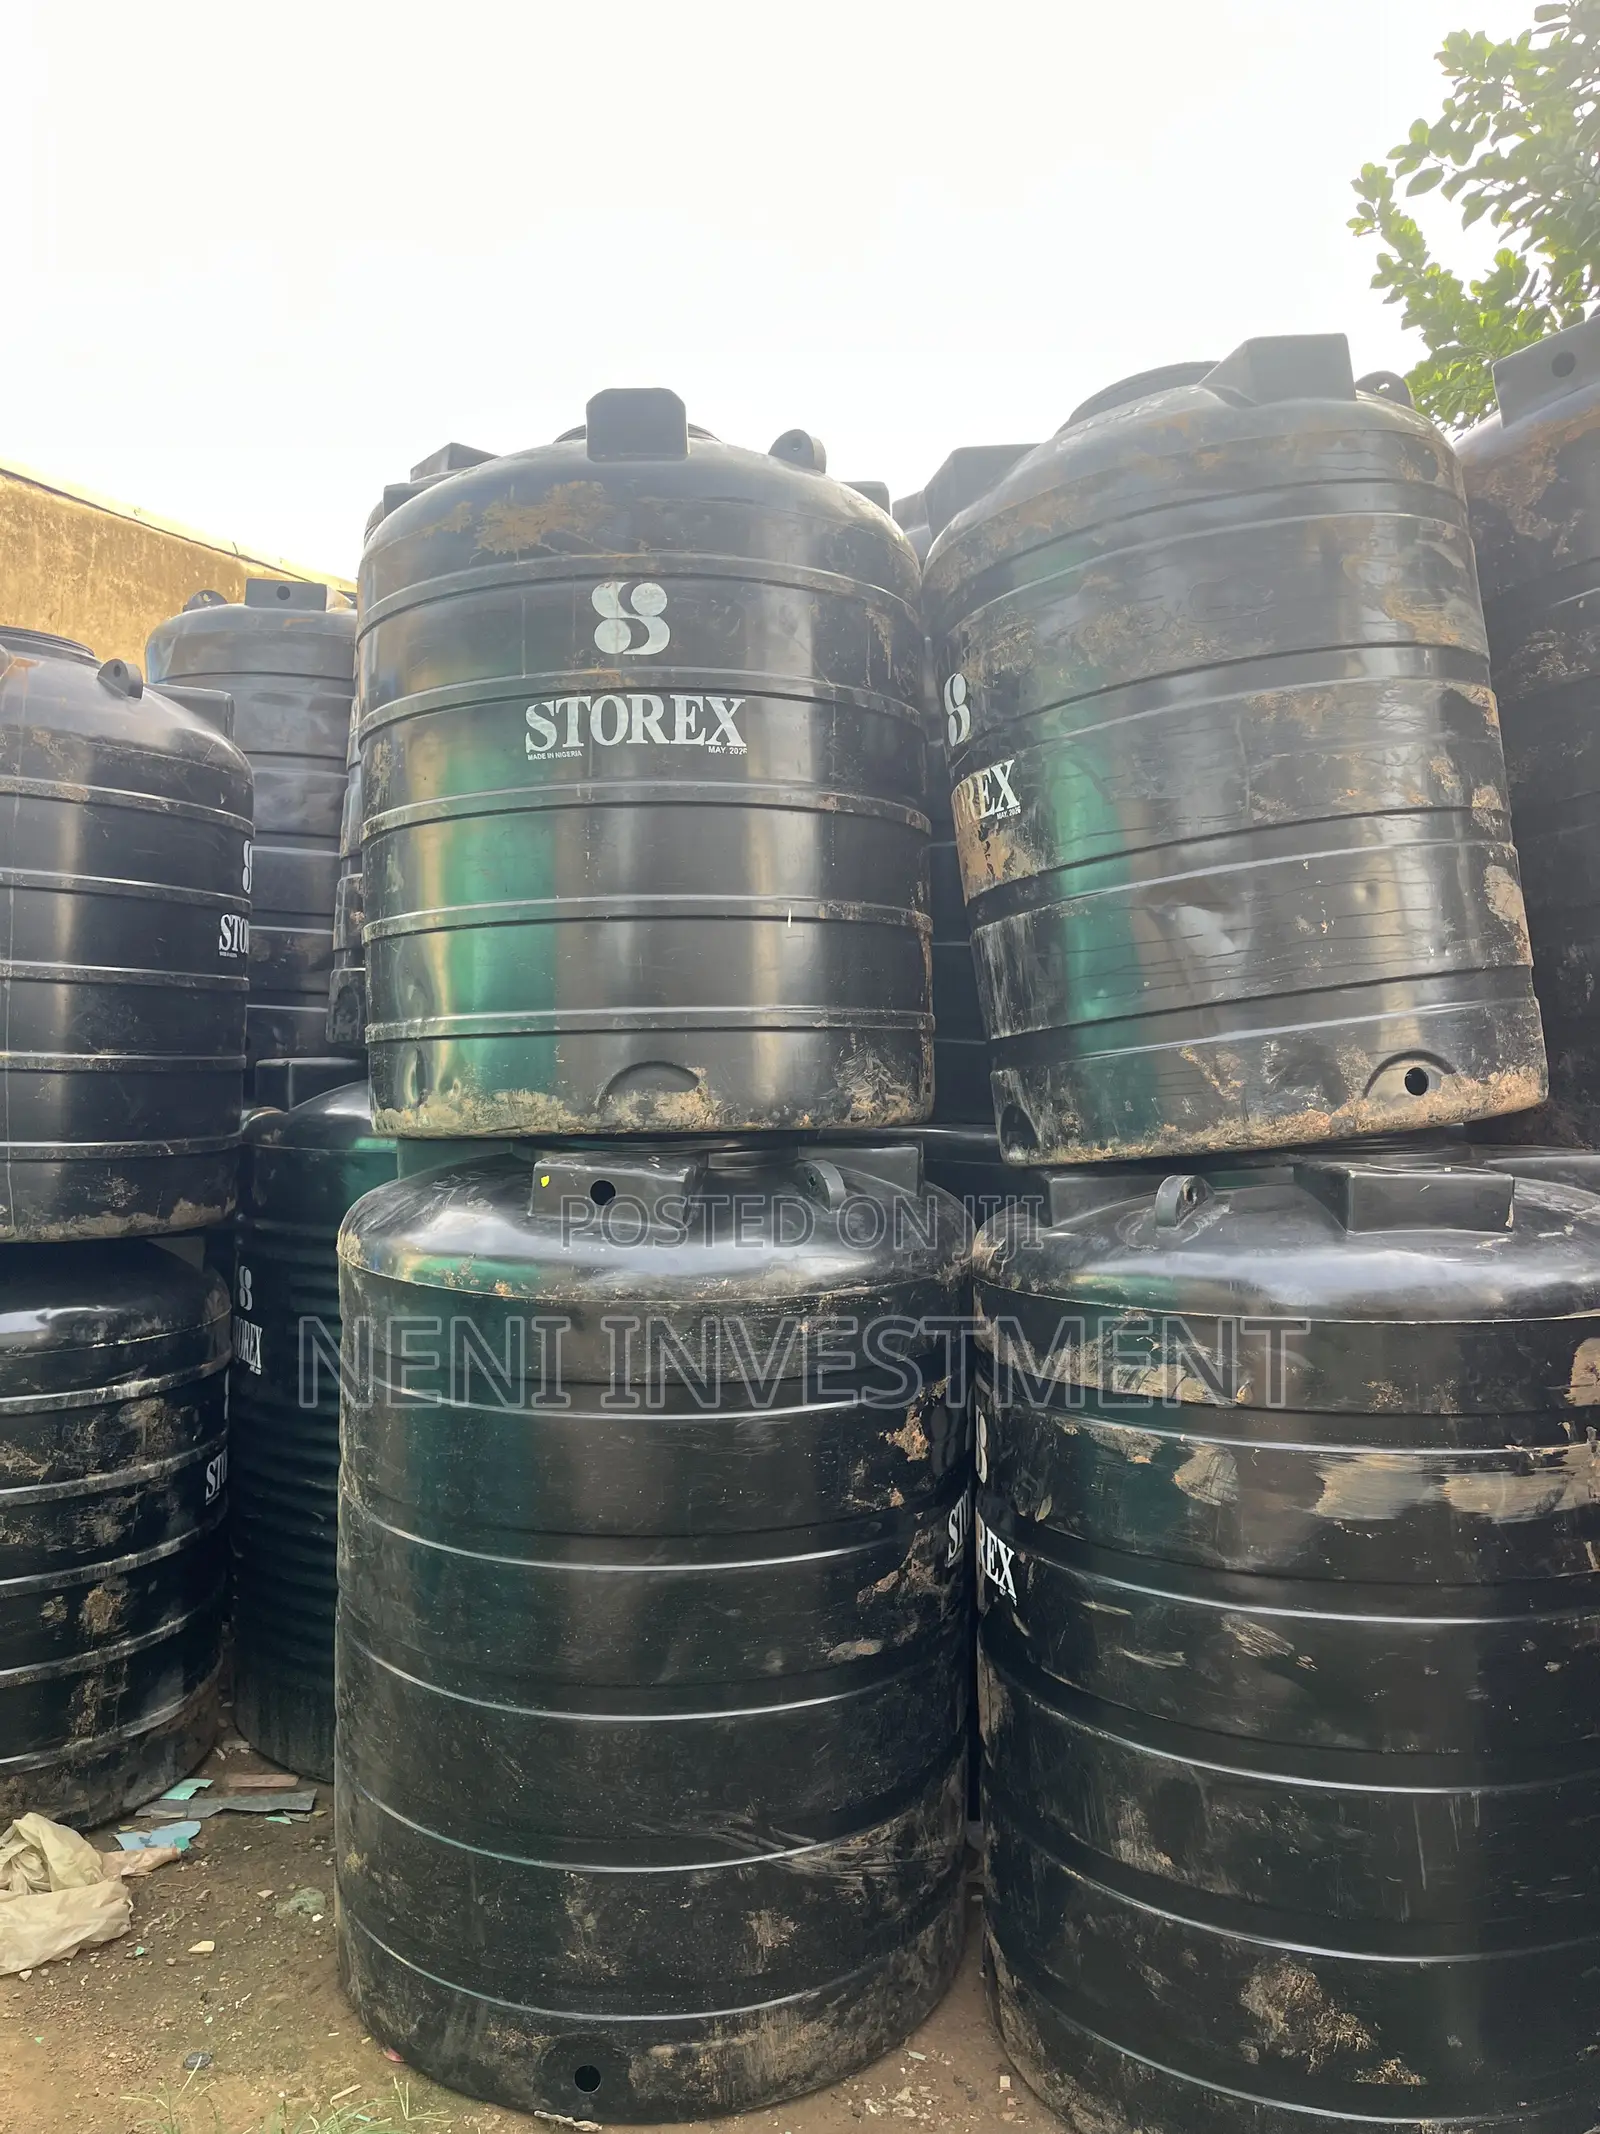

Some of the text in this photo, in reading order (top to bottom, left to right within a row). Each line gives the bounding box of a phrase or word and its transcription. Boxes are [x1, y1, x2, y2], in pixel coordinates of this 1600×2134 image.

[525, 694, 747, 753] STOREX
[555, 750, 582, 759] NIGERIA
[219, 914, 249, 954] STO
